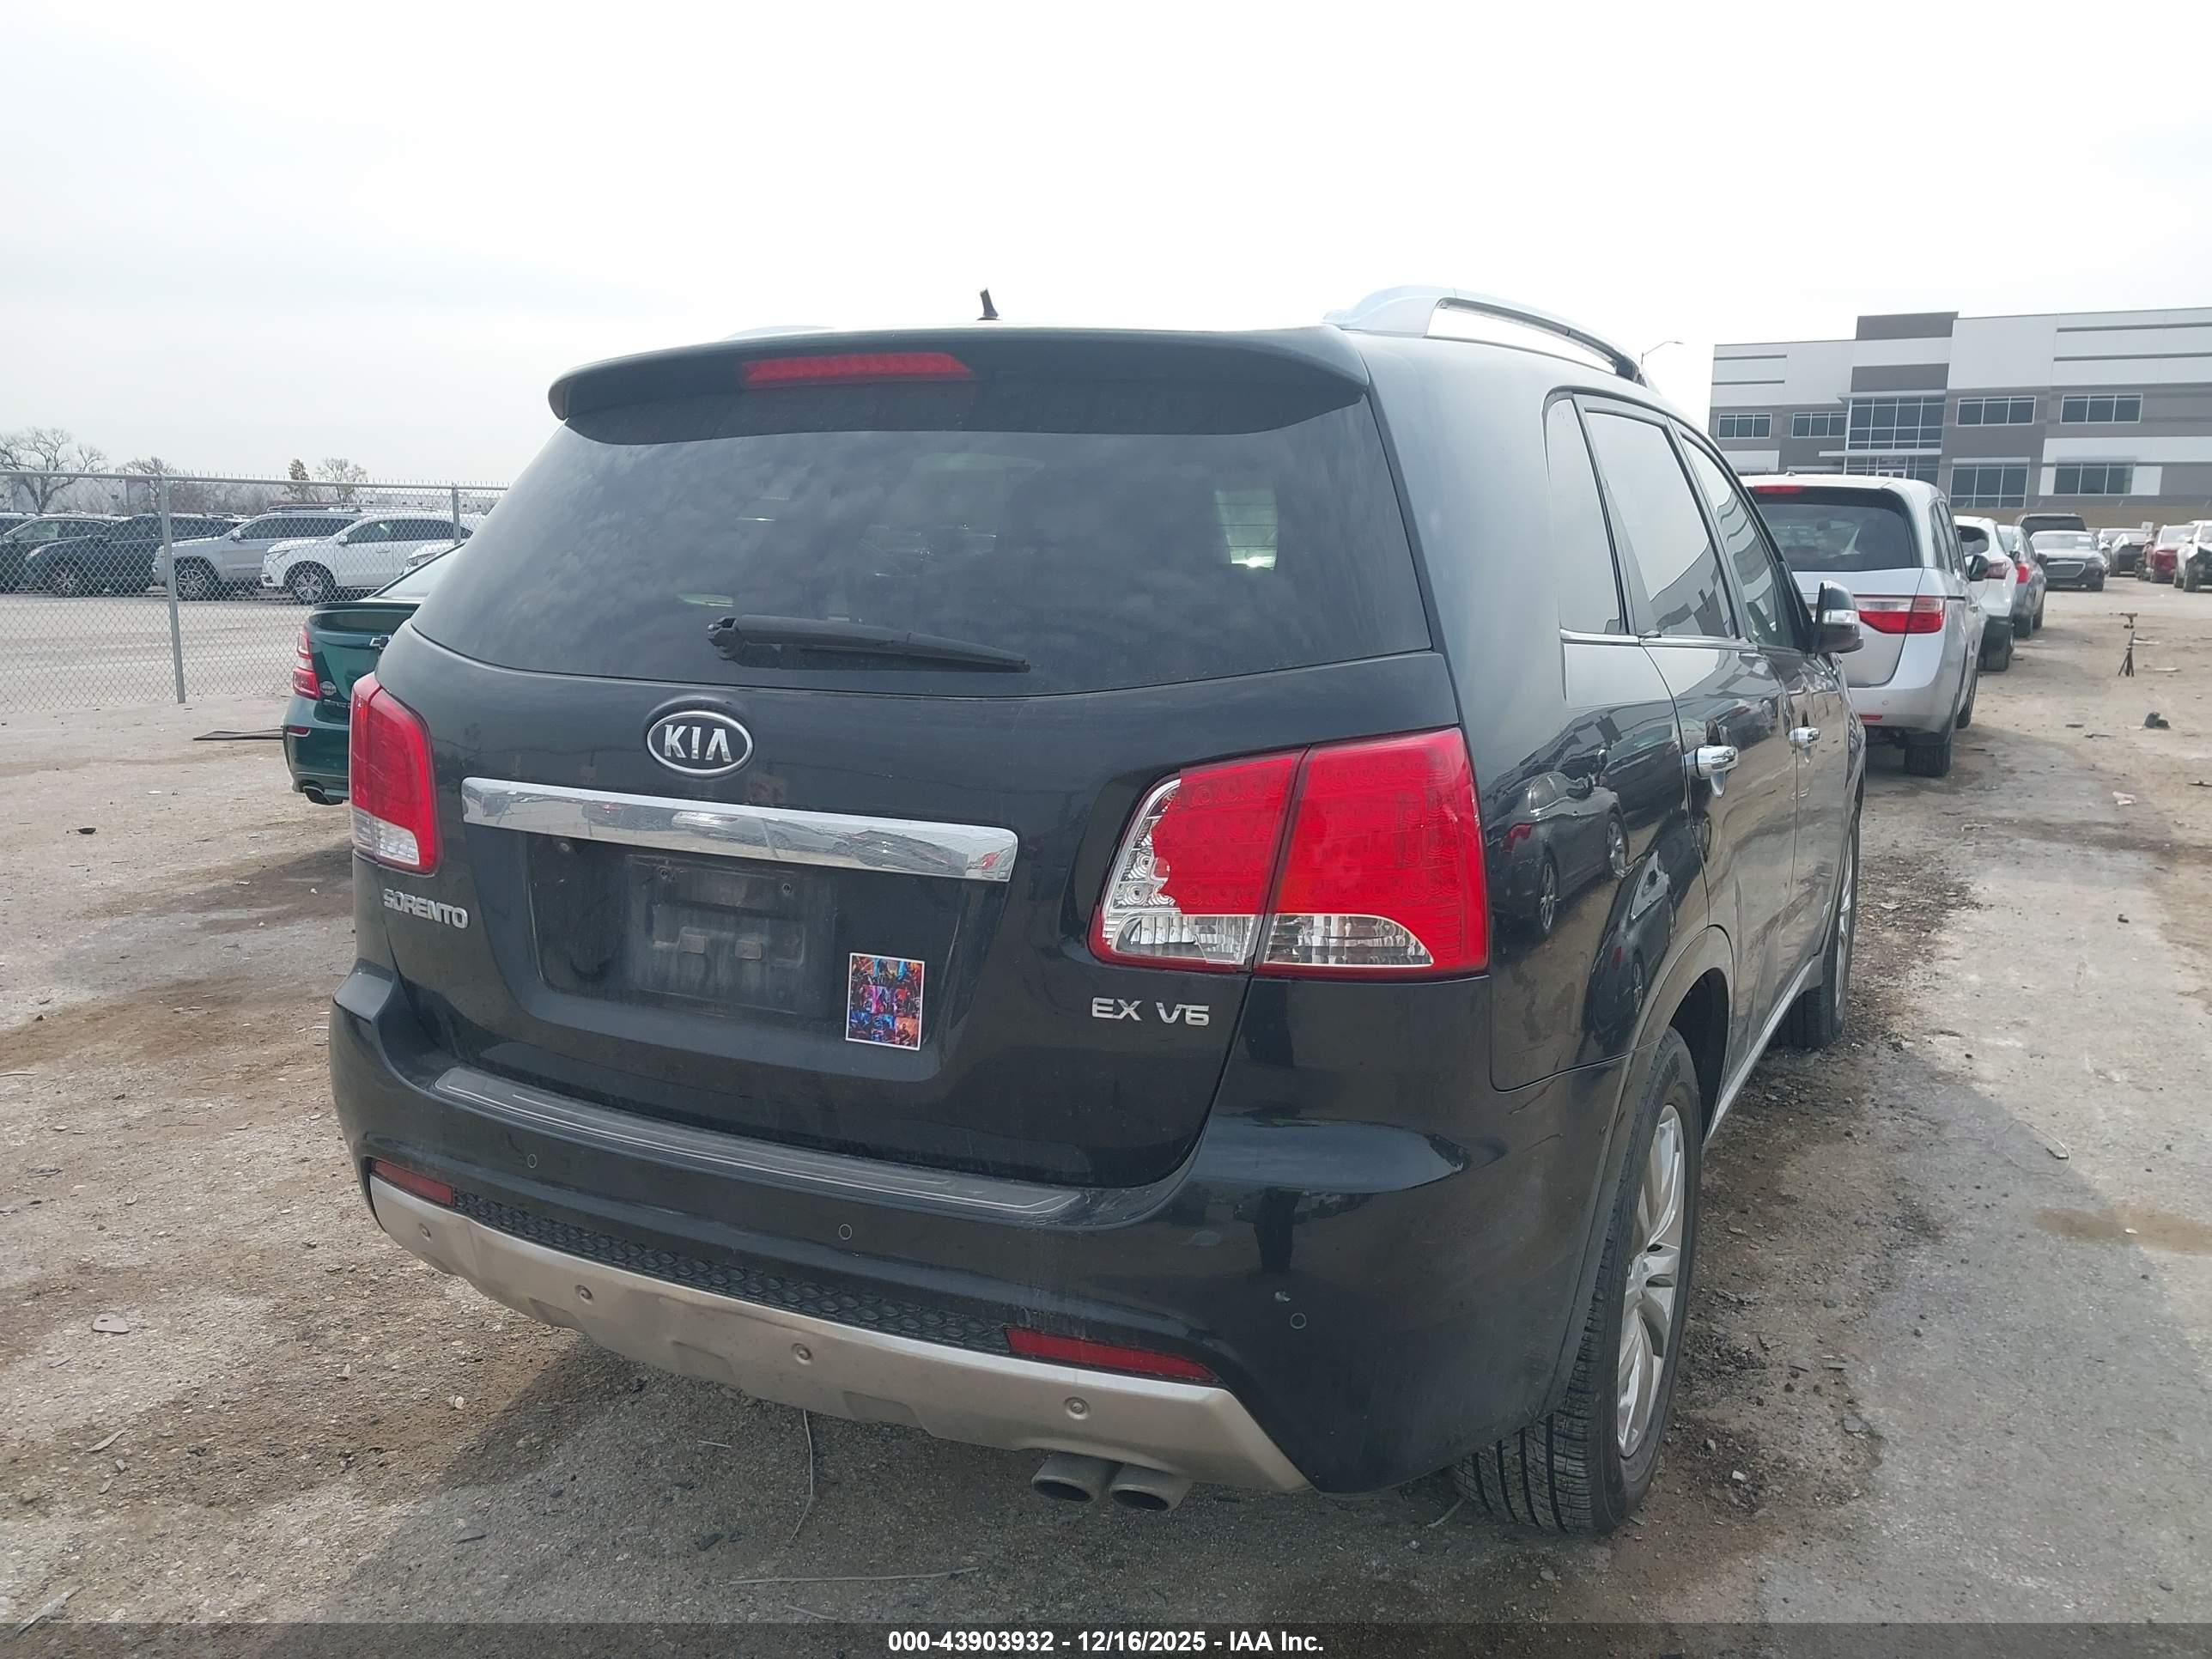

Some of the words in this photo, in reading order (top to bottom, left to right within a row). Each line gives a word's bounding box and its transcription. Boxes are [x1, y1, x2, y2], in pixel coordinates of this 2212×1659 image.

[664, 724, 732, 763] KIA
[383, 888, 468, 929] SORENTO
[1091, 997, 1143, 1021] EX
[1155, 1001, 1210, 1026] V6
